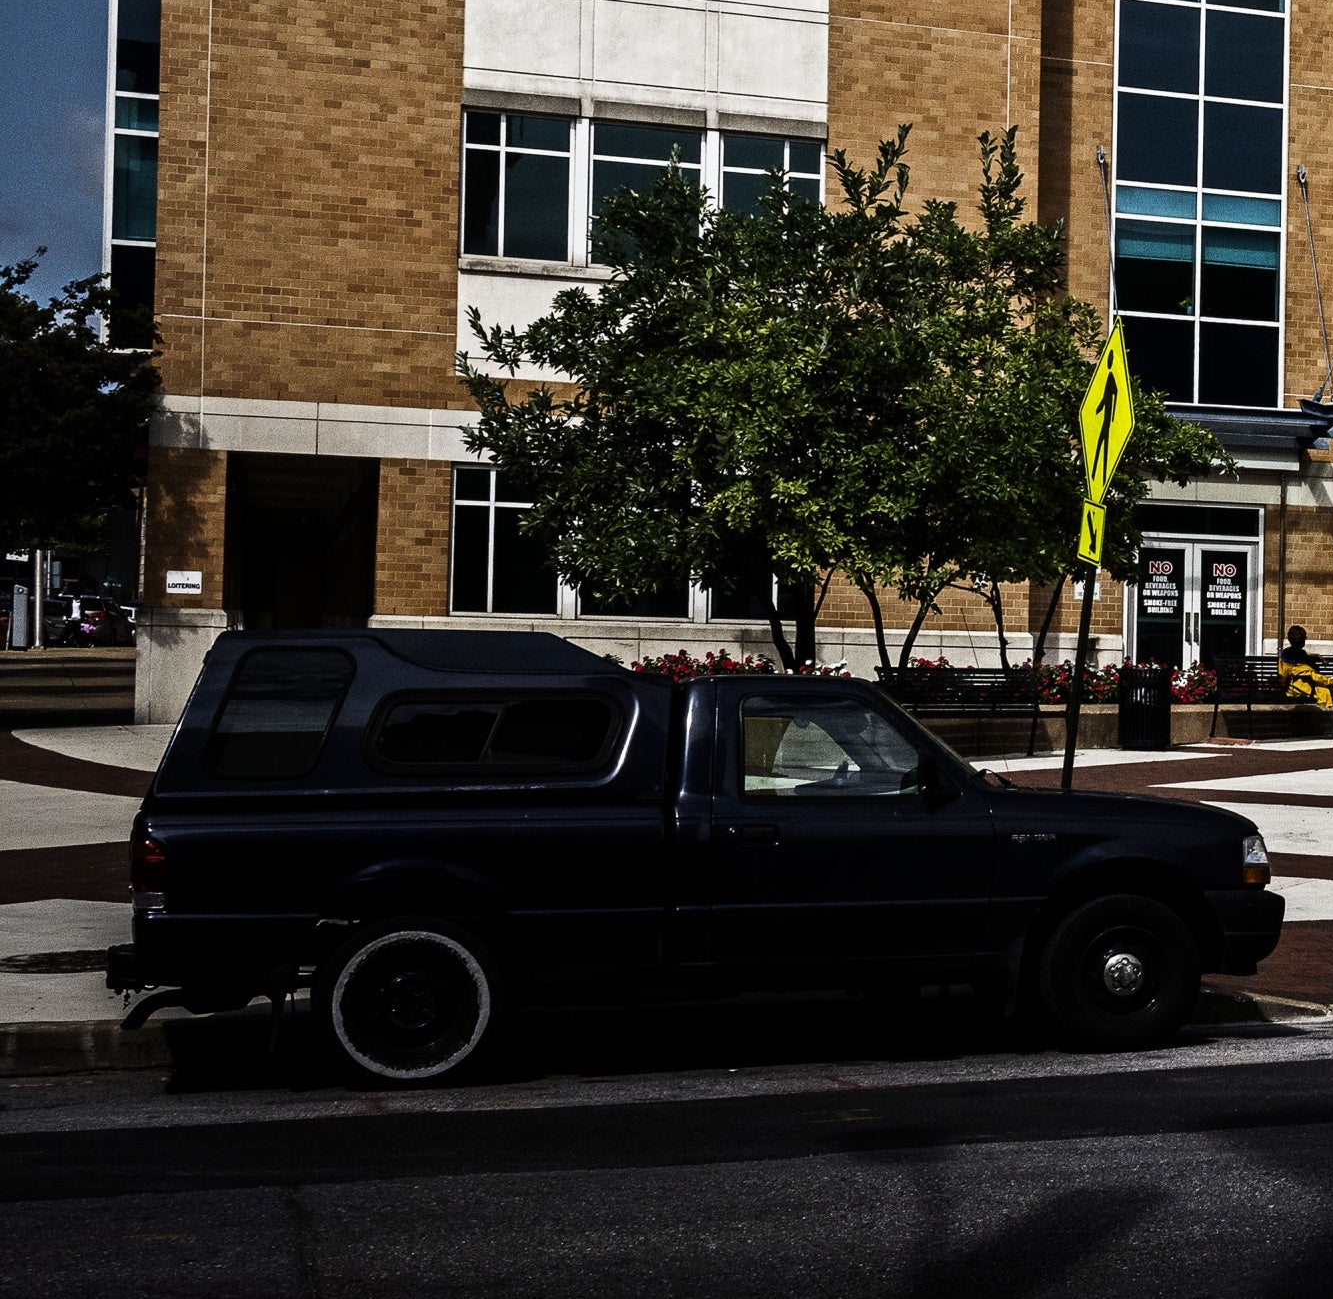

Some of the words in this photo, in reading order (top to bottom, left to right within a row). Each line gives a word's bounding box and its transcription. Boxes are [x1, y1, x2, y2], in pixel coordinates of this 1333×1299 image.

[1149, 561, 1173, 574] NO
[1213, 563, 1237, 577] NO
[1145, 582, 1176, 590] BEVERAGES
[1209, 584, 1240, 592] BEVERAGES
[1152, 589, 1178, 597] WEAPONS
[1143, 599, 1177, 607] SMOKE-FREE
[1207, 601, 1241, 609] SMOKE-FREE
[1147, 606, 1174, 614] BUILDING
[1210, 608, 1237, 616] BUILDING
